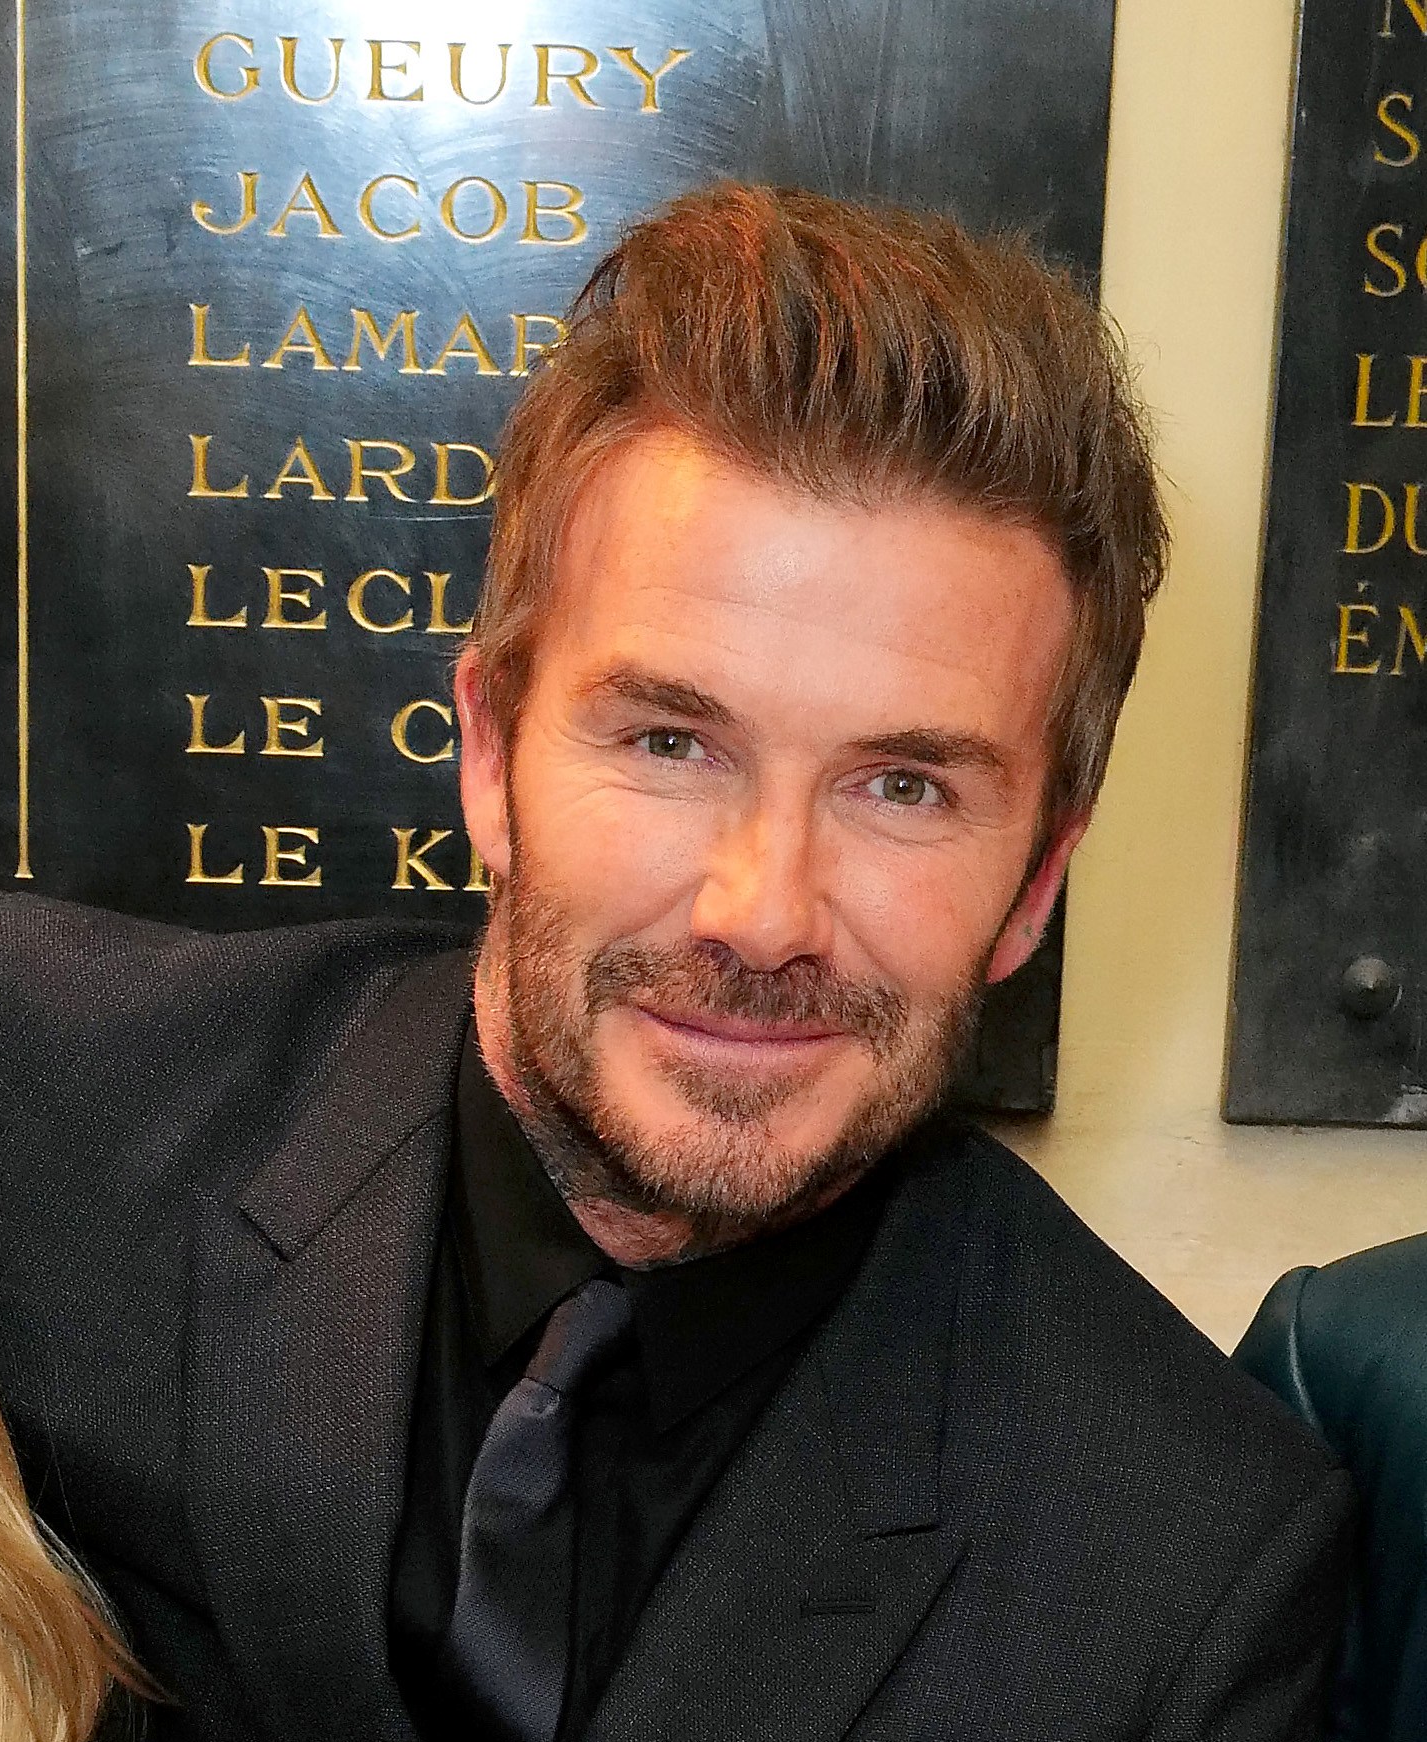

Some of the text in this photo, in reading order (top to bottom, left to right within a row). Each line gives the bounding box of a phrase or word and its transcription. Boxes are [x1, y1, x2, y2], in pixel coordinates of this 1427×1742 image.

[195, 34, 692, 114] GUEURY
[193, 171, 589, 246] JACOB
[187, 434, 497, 507] LARD
[186, 564, 475, 634] LECL
[186, 693, 324, 760] LE
[185, 823, 322, 887] LE
